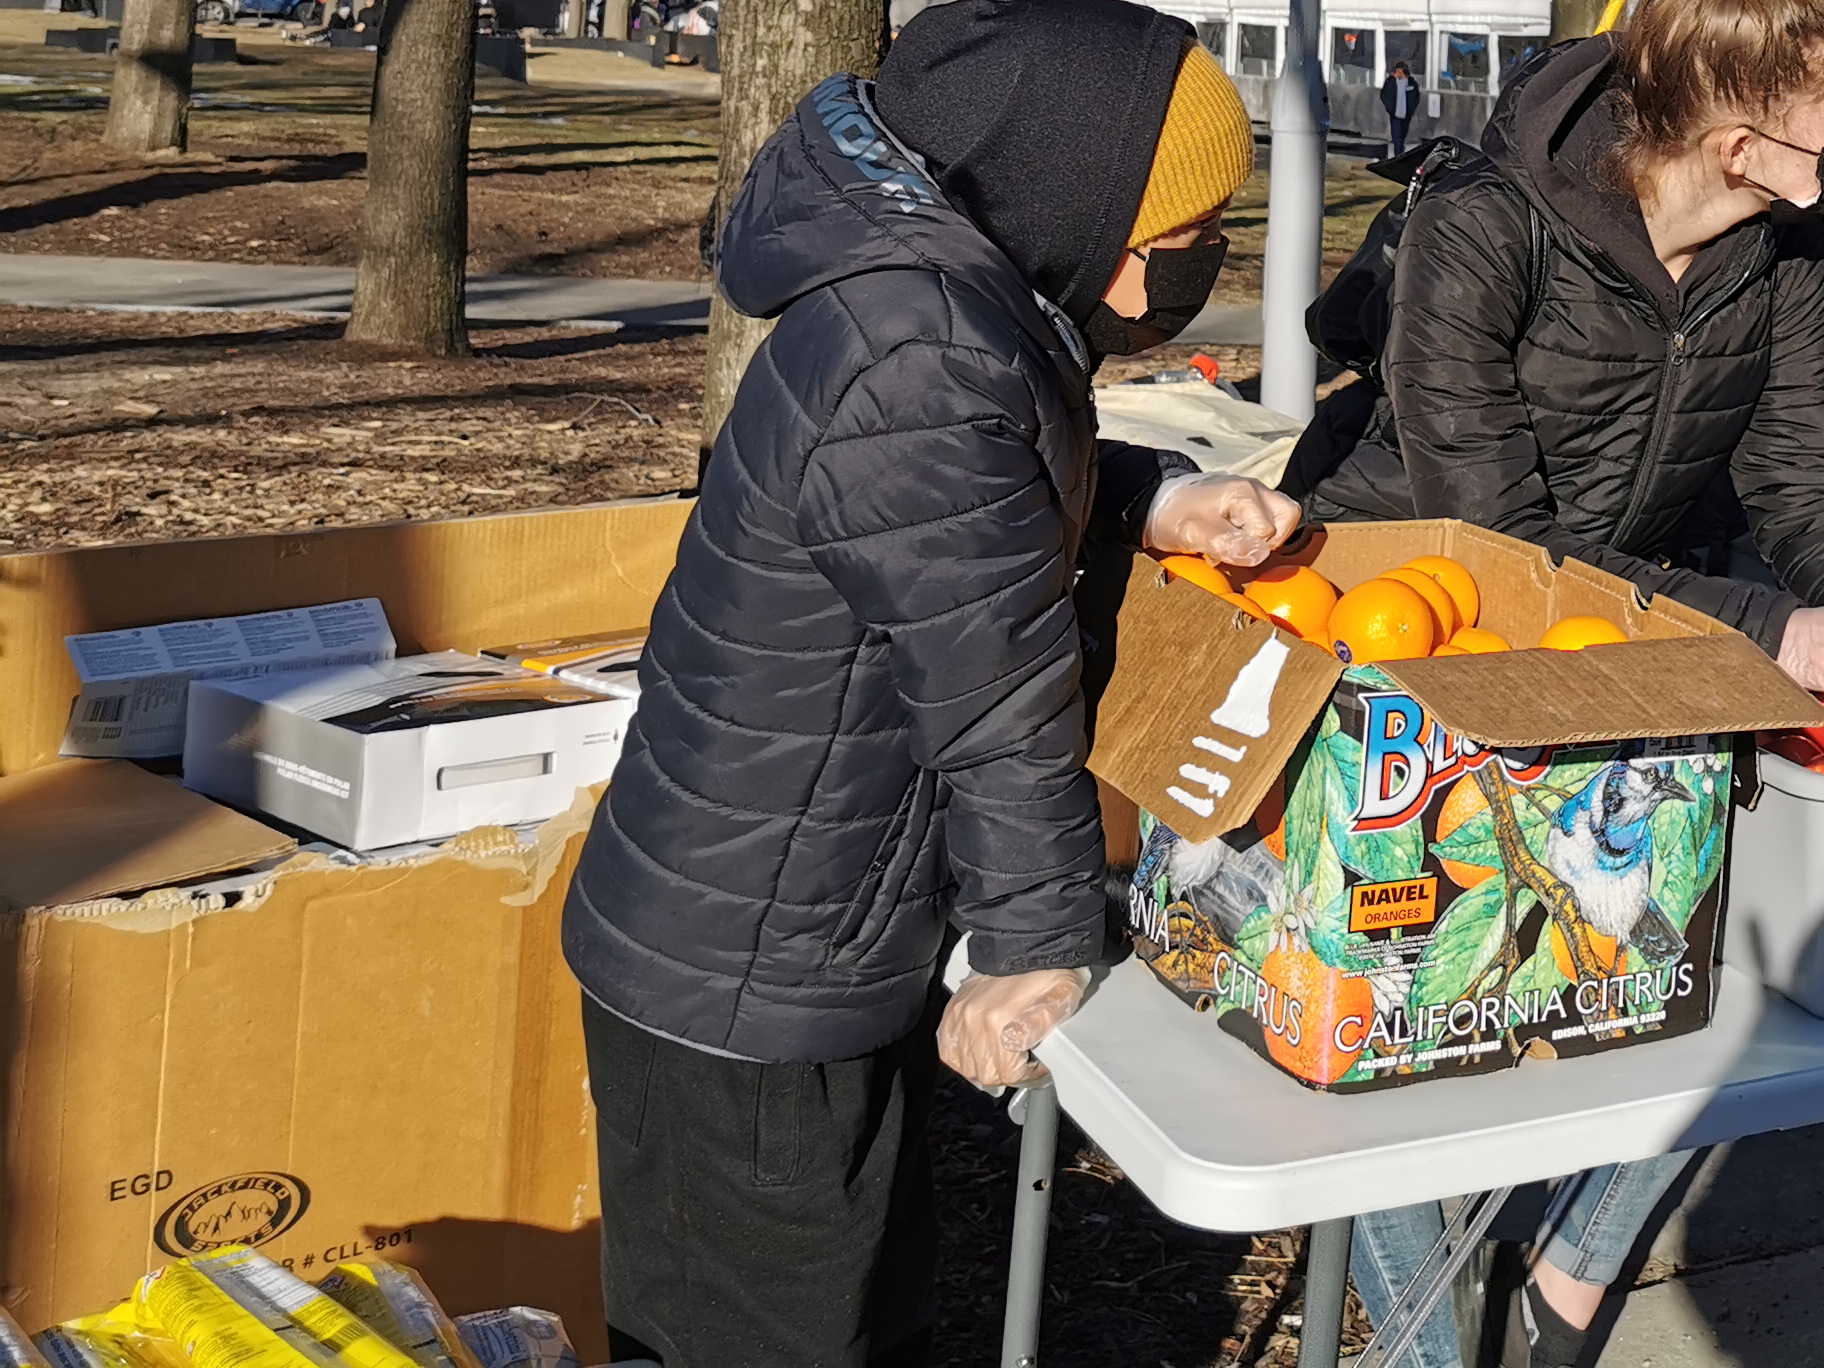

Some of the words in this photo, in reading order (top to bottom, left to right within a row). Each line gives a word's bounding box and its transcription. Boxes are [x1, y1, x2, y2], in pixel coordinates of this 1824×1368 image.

[1359, 883, 1429, 907] NAVEL
[1364, 907, 1422, 924] ORANGES
[1128, 883, 1170, 952] RNIA
[1213, 951, 1302, 1047] CITRUS
[1342, 960, 1436, 980] www.johnstonfarms.com
[1333, 987, 1567, 1053] CALIFORNIA
[1574, 963, 1694, 1012] CITRUS
[1552, 1026, 1587, 1041] EDISON,
[1588, 1016, 1638, 1036] CALIFORNIA
[1639, 1010, 1667, 1025] 93220
[1358, 1054, 1397, 1071] PACKED
[1399, 1051, 1413, 1064] BY
[1414, 1044, 1466, 1062] JOHNSTON
[1468, 1040, 1502, 1056] FARMS
[109, 1169, 174, 1202] EGD
[183, 1176, 291, 1222] JACKFIELD
[323, 1229, 414, 1263] CLL-801
